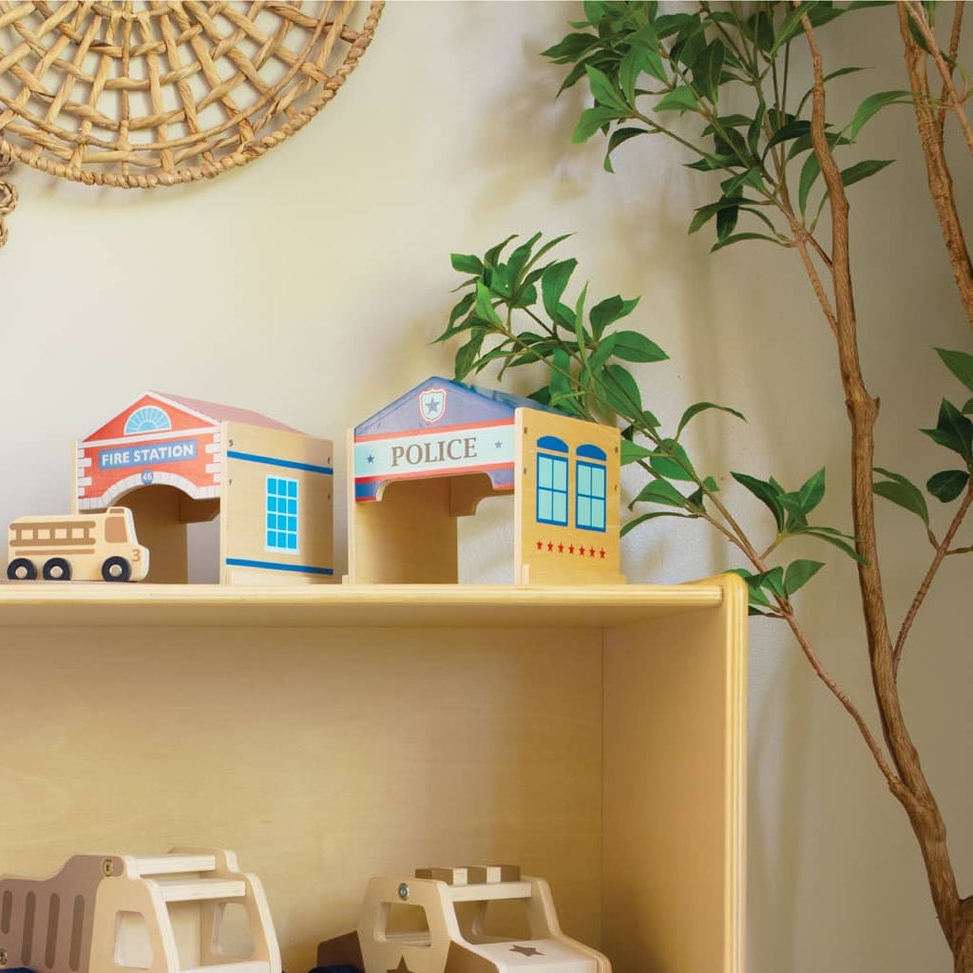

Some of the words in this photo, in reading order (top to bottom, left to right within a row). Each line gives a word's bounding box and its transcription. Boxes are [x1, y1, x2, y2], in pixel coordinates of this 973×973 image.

[101, 451, 130, 467] FIRE
[133, 443, 194, 462] STATION
[390, 437, 477, 467] POLICE
[132, 549, 141, 562] 3
